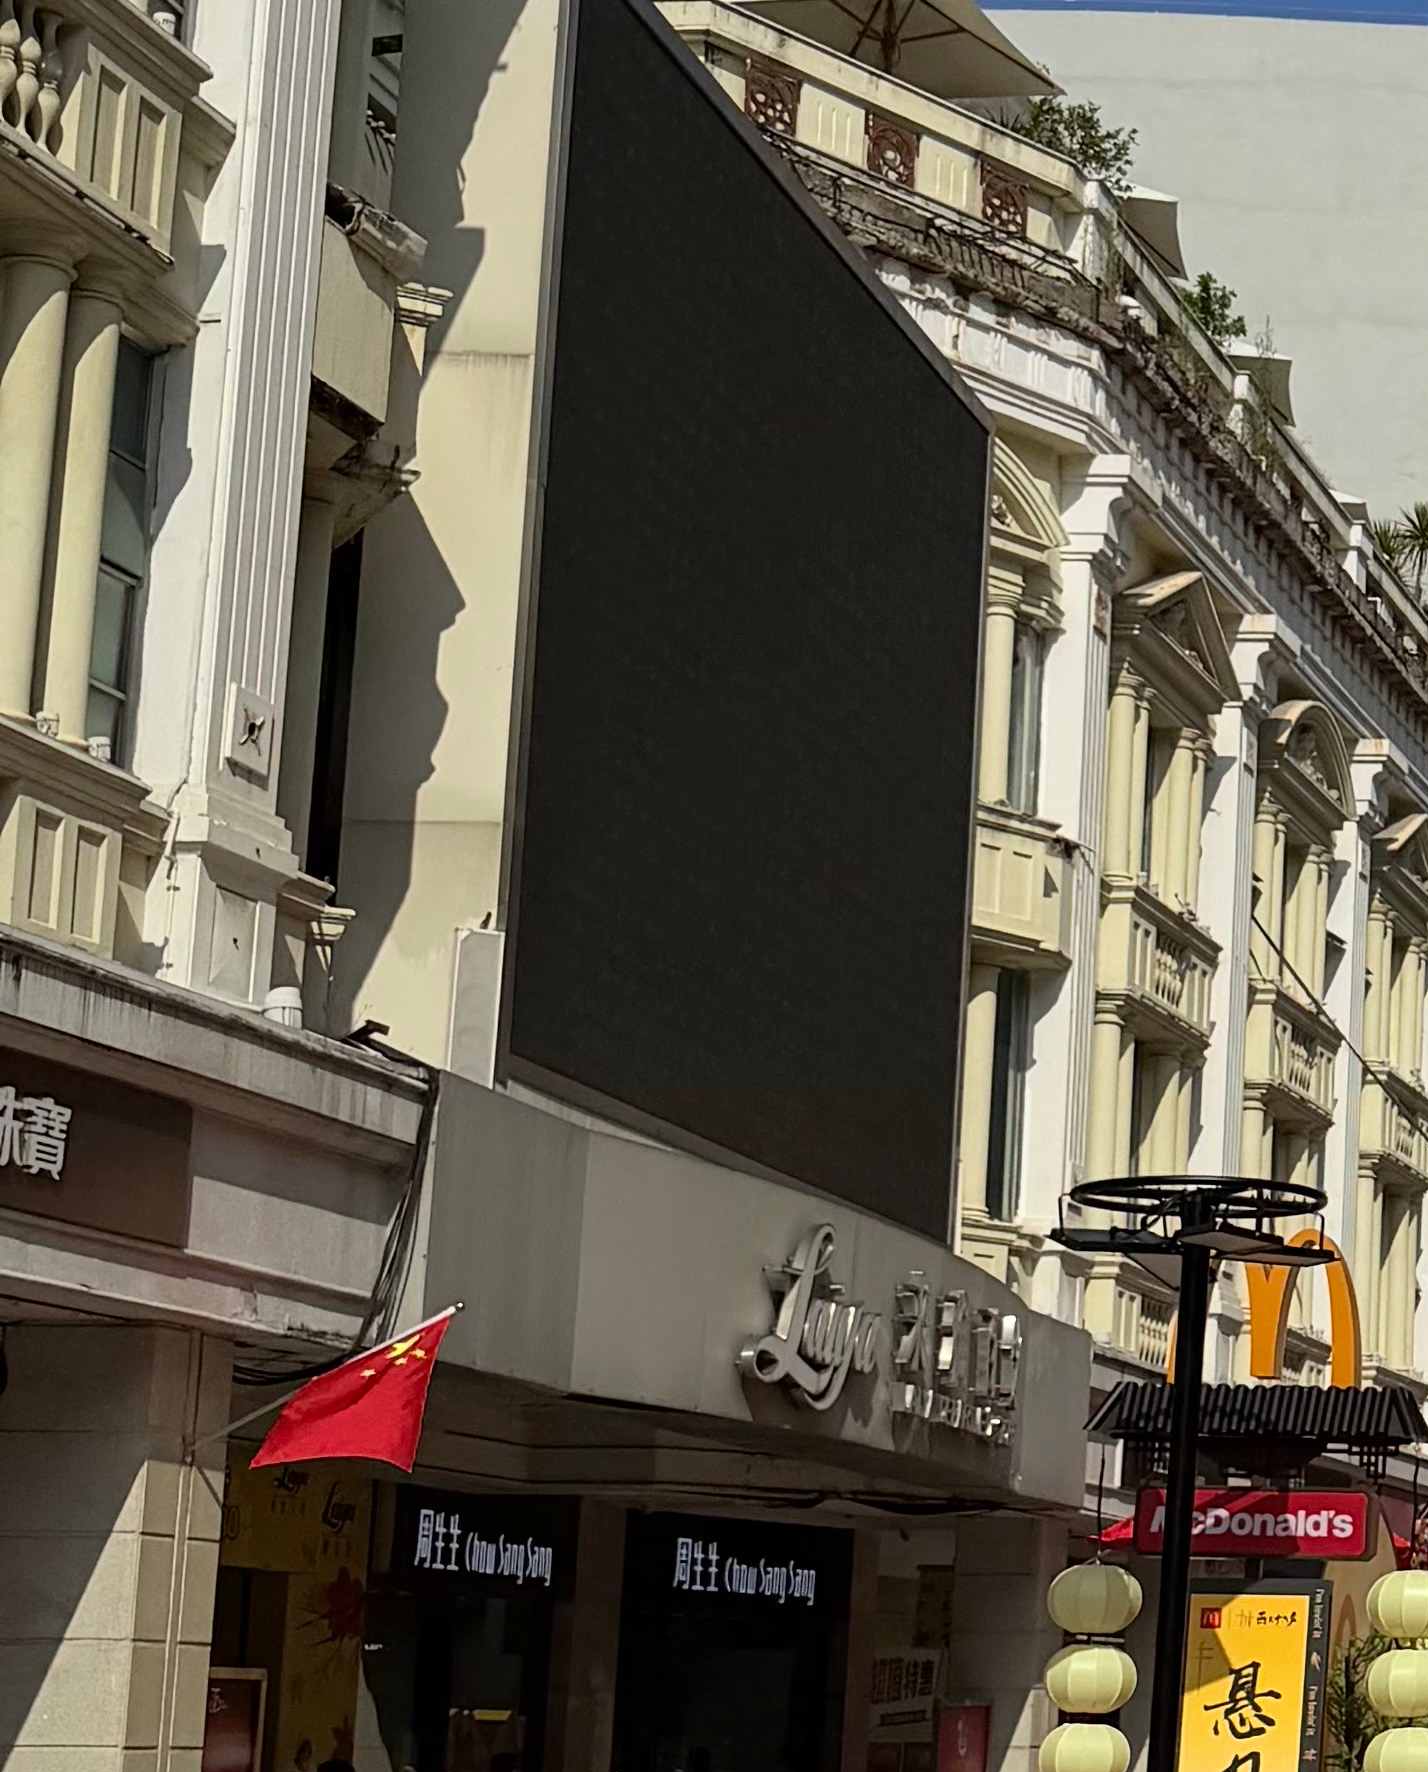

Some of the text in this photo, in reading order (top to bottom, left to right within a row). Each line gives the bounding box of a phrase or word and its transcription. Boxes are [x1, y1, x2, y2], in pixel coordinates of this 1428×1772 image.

[414, 1509, 462, 1571] 周生生
[673, 1537, 721, 1592] 周生生
